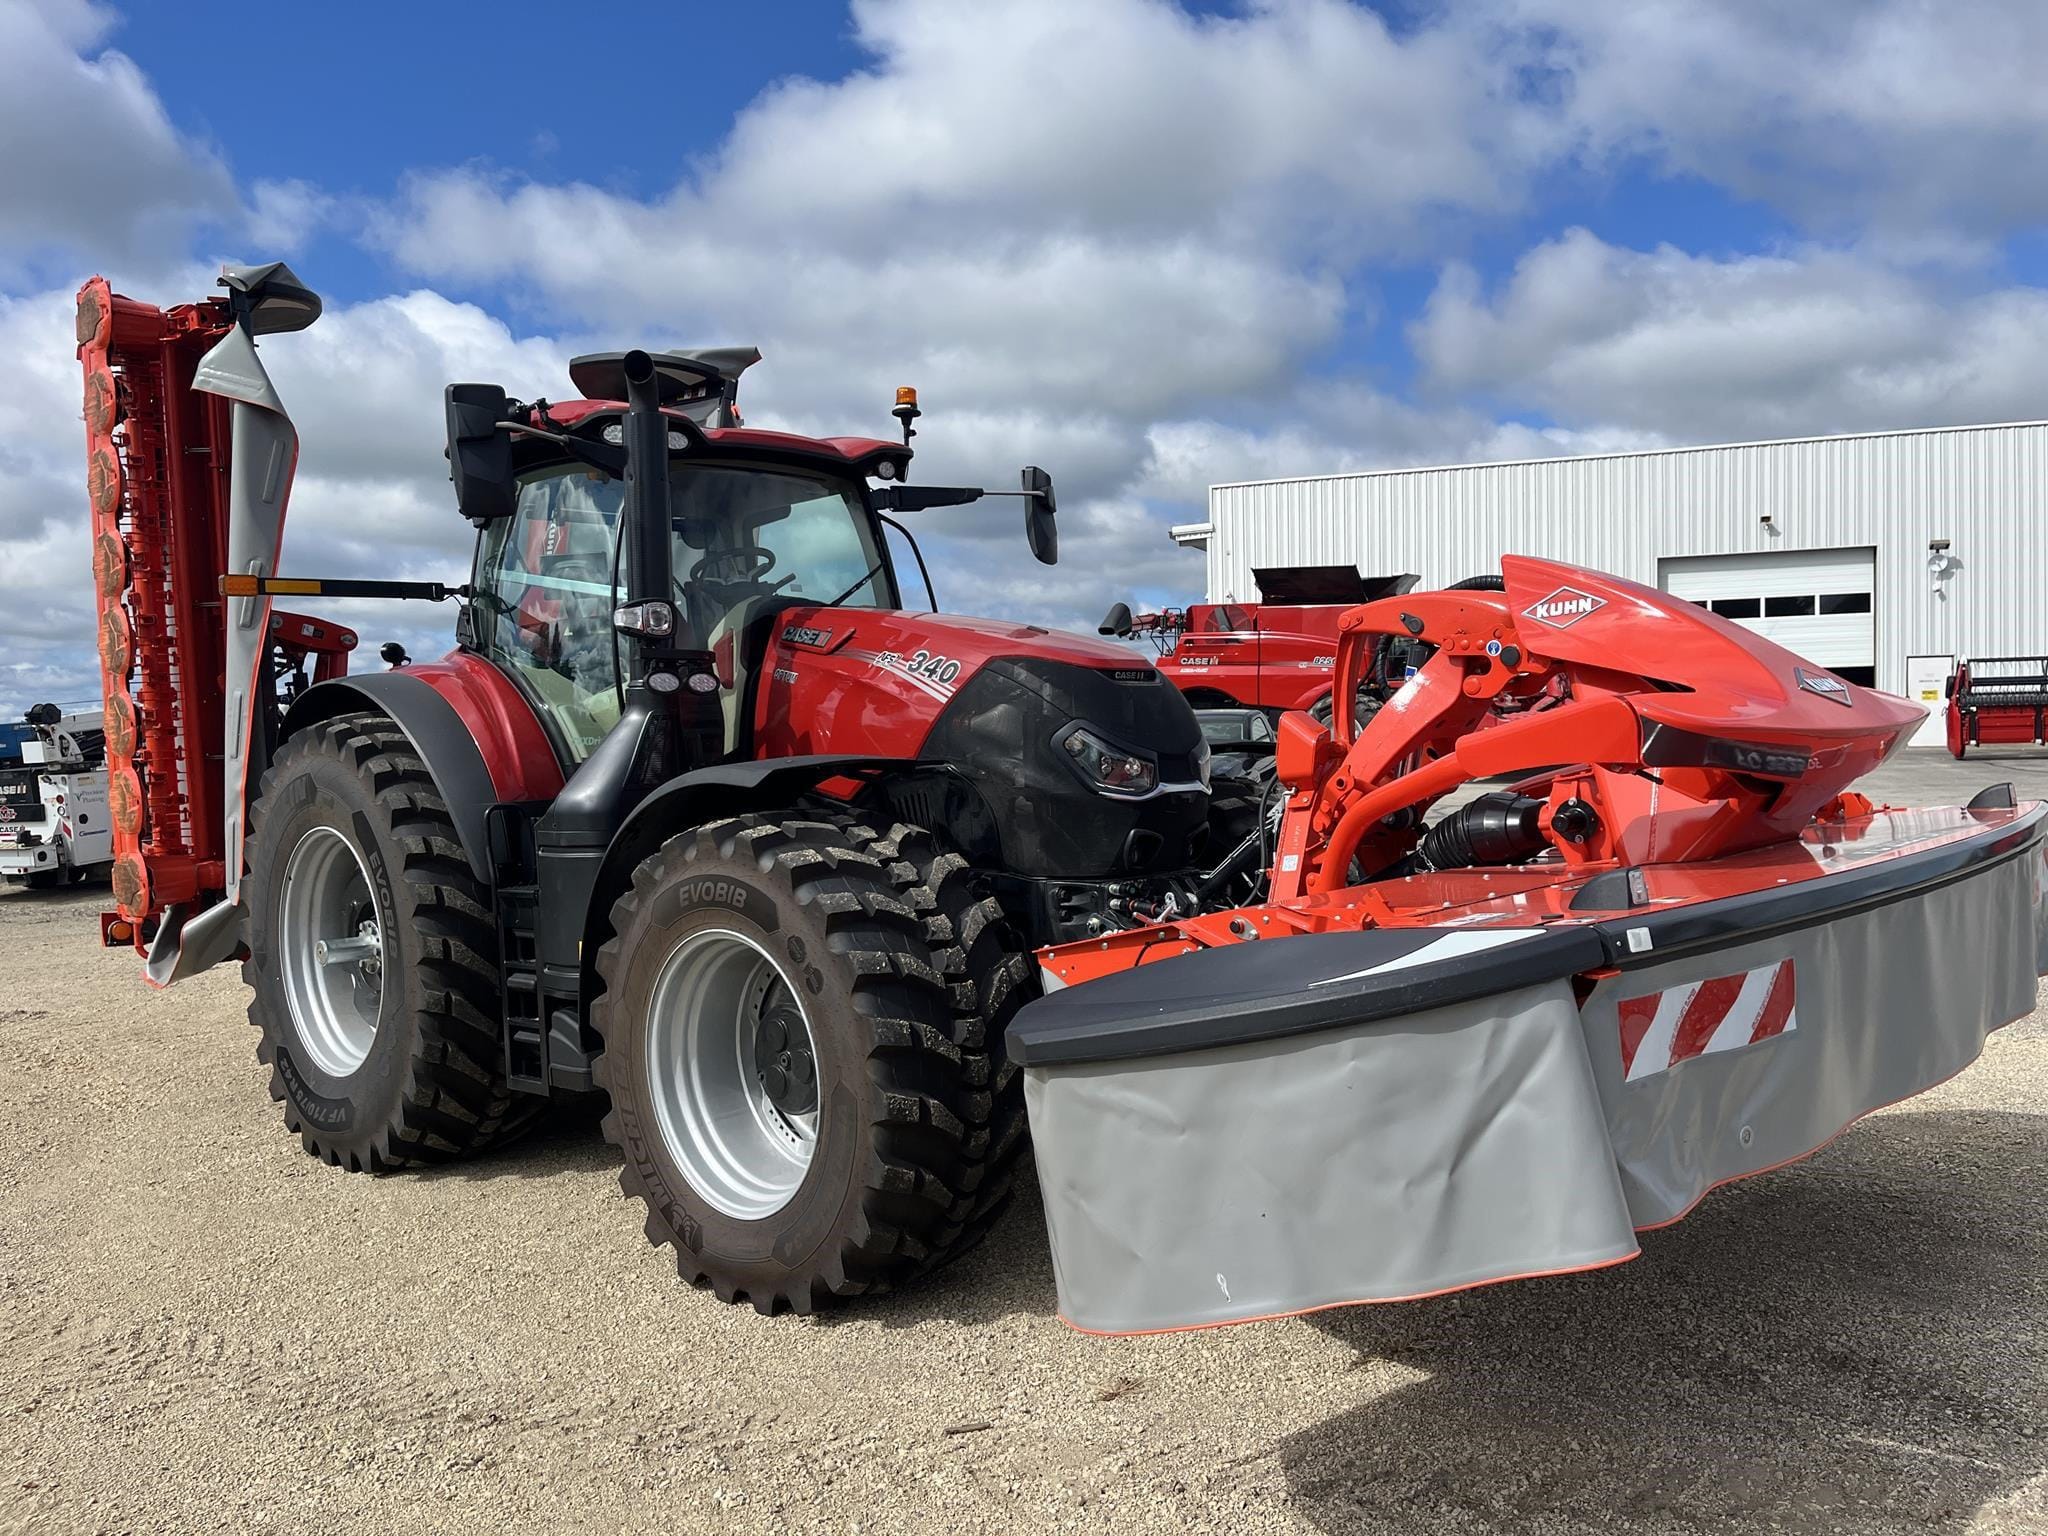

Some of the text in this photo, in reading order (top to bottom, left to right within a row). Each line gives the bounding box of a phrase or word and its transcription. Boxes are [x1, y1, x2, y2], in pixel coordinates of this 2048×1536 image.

[1536, 598, 1592, 618] KUHN
[782, 626, 817, 644] CASE
[877, 651, 898, 665] AFS
[1180, 657, 1209, 665] CASE
[774, 668, 798, 684] OPTUM
[907, 651, 960, 684] 340
[1115, 671, 1137, 680] CASE
[0, 785, 17, 795] ASE
[680, 881, 748, 908] EVOBIB
[369, 850, 398, 960] EVOBIB
[295, 1089, 327, 1121] 710/75
[327, 1107, 346, 1123] VF
